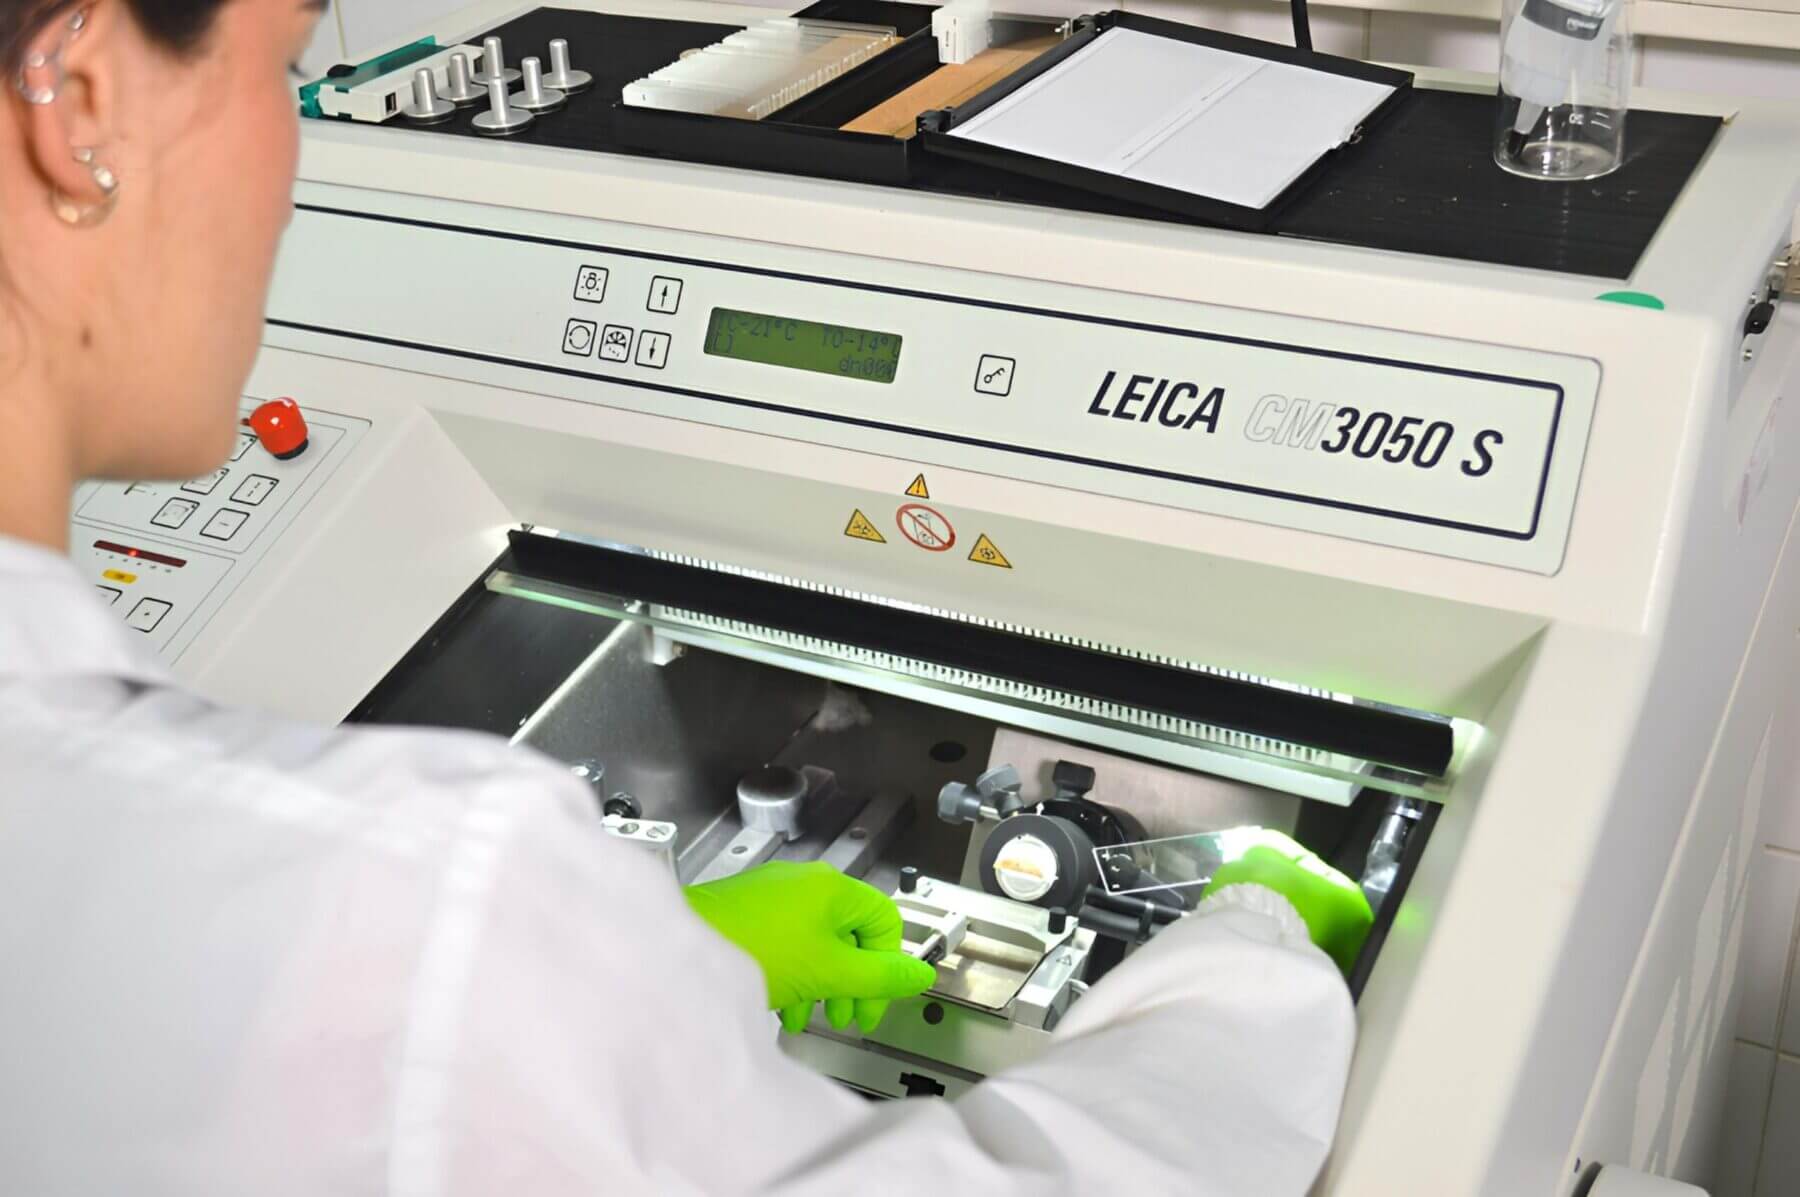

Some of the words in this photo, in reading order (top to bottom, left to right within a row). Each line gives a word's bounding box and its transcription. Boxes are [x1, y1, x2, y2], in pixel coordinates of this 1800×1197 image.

[1087, 371, 1226, 434] LEICA
[1243, 394, 1455, 470] CM3050
[1460, 429, 1504, 478] S
